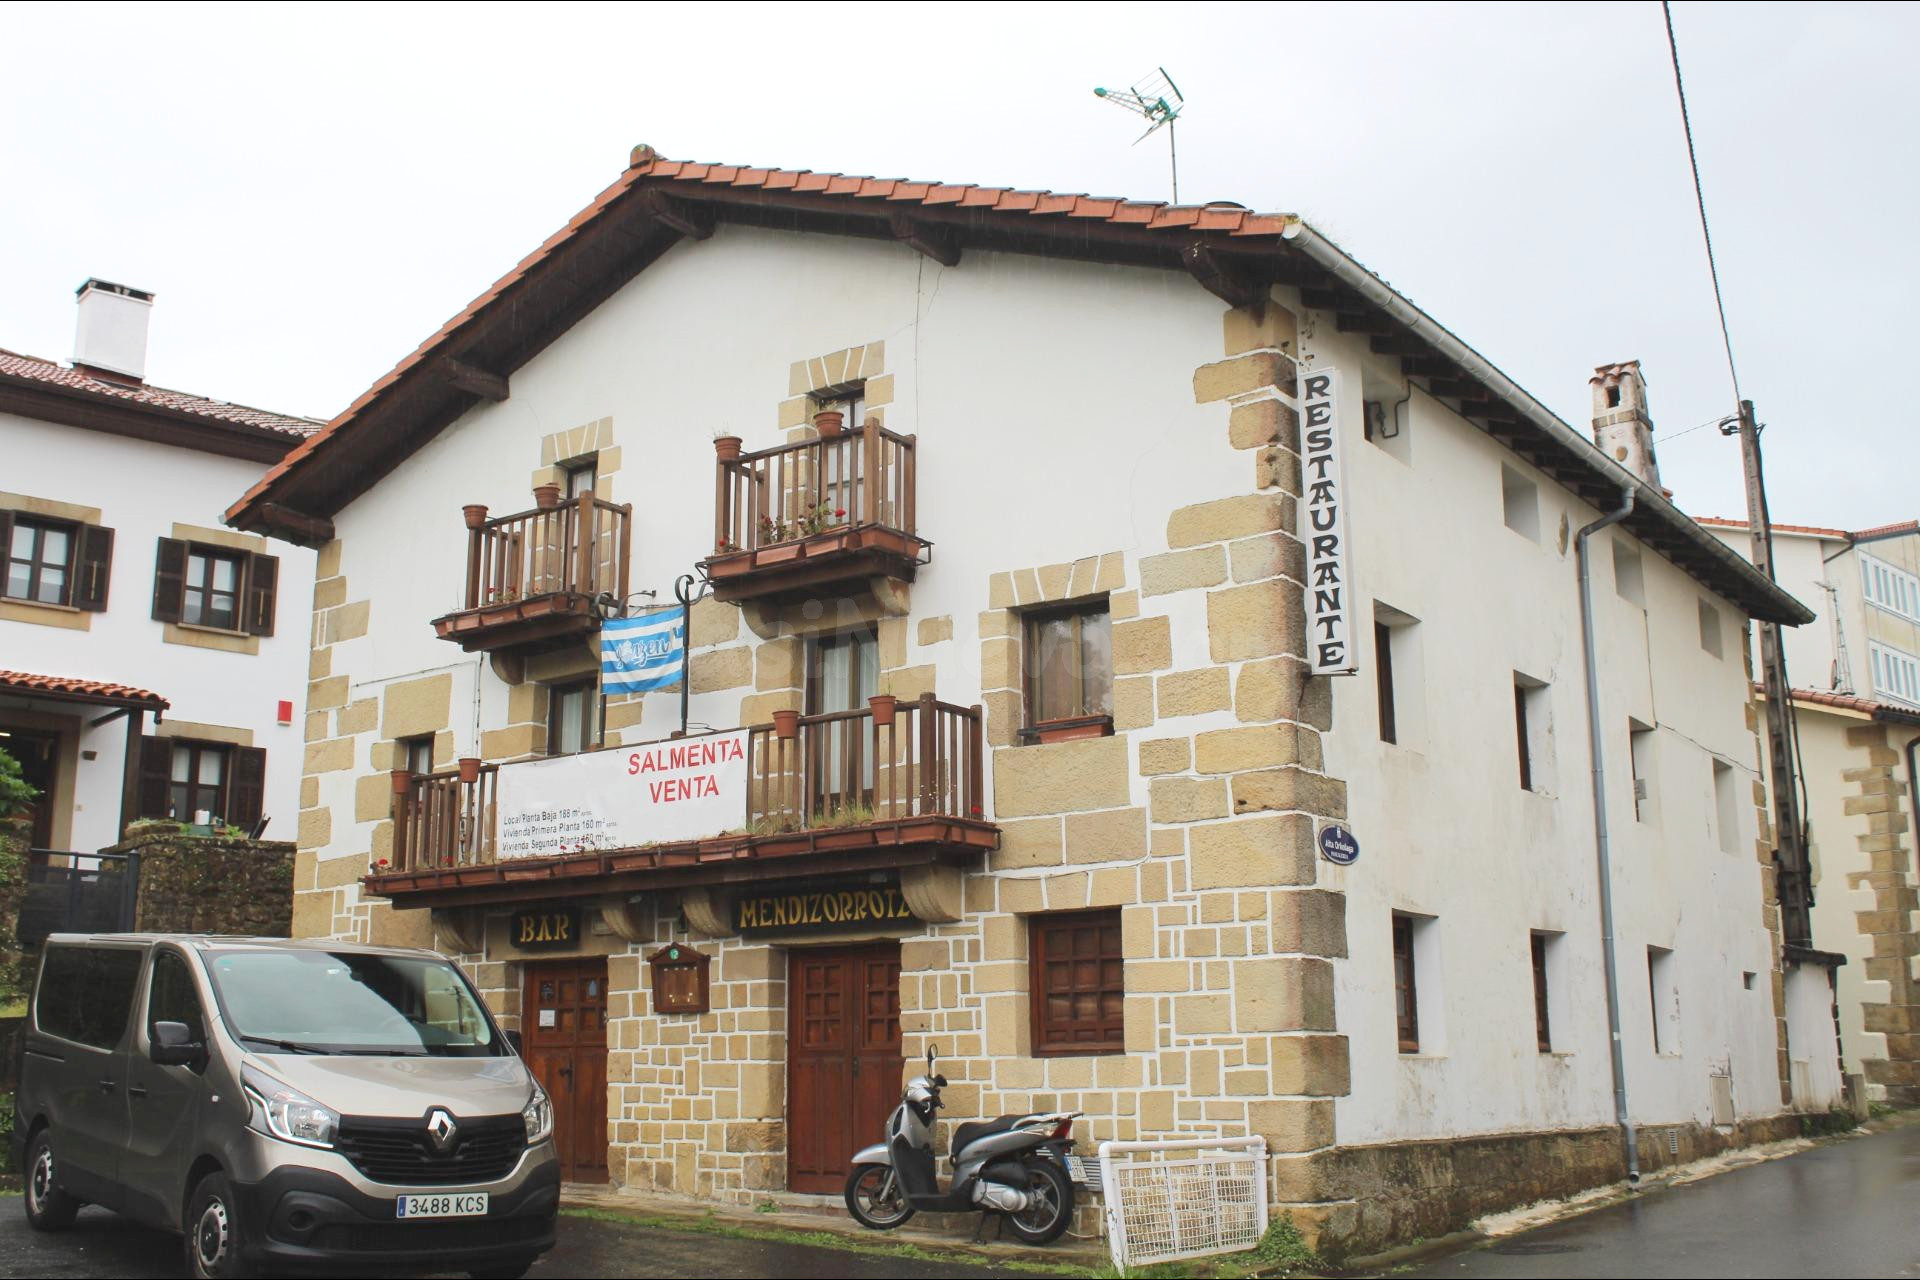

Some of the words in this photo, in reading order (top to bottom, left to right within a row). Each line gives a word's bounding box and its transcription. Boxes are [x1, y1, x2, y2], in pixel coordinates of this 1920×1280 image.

[1304, 374, 1345, 668] RESTAURANTE
[628, 738, 744, 775] SALMENTA
[650, 775, 719, 803] VENTA
[503, 814, 521, 826] Local
[521, 811, 541, 823] Planta
[541, 810, 557, 822] Baja
[503, 826, 531, 839] Vivienda
[531, 825, 557, 836] Primera
[559, 822, 580, 832] Planta
[582, 819, 593, 829] 160
[502, 840, 529, 852] Vivienda
[531, 839, 558, 851] Segunda
[559, 836, 580, 847] Planta
[739, 889, 911, 928] MENDIZORROTZ
[520, 914, 569, 942] BAR
[409, 1197, 450, 1215] 3488
[455, 1196, 485, 1213] KCS
